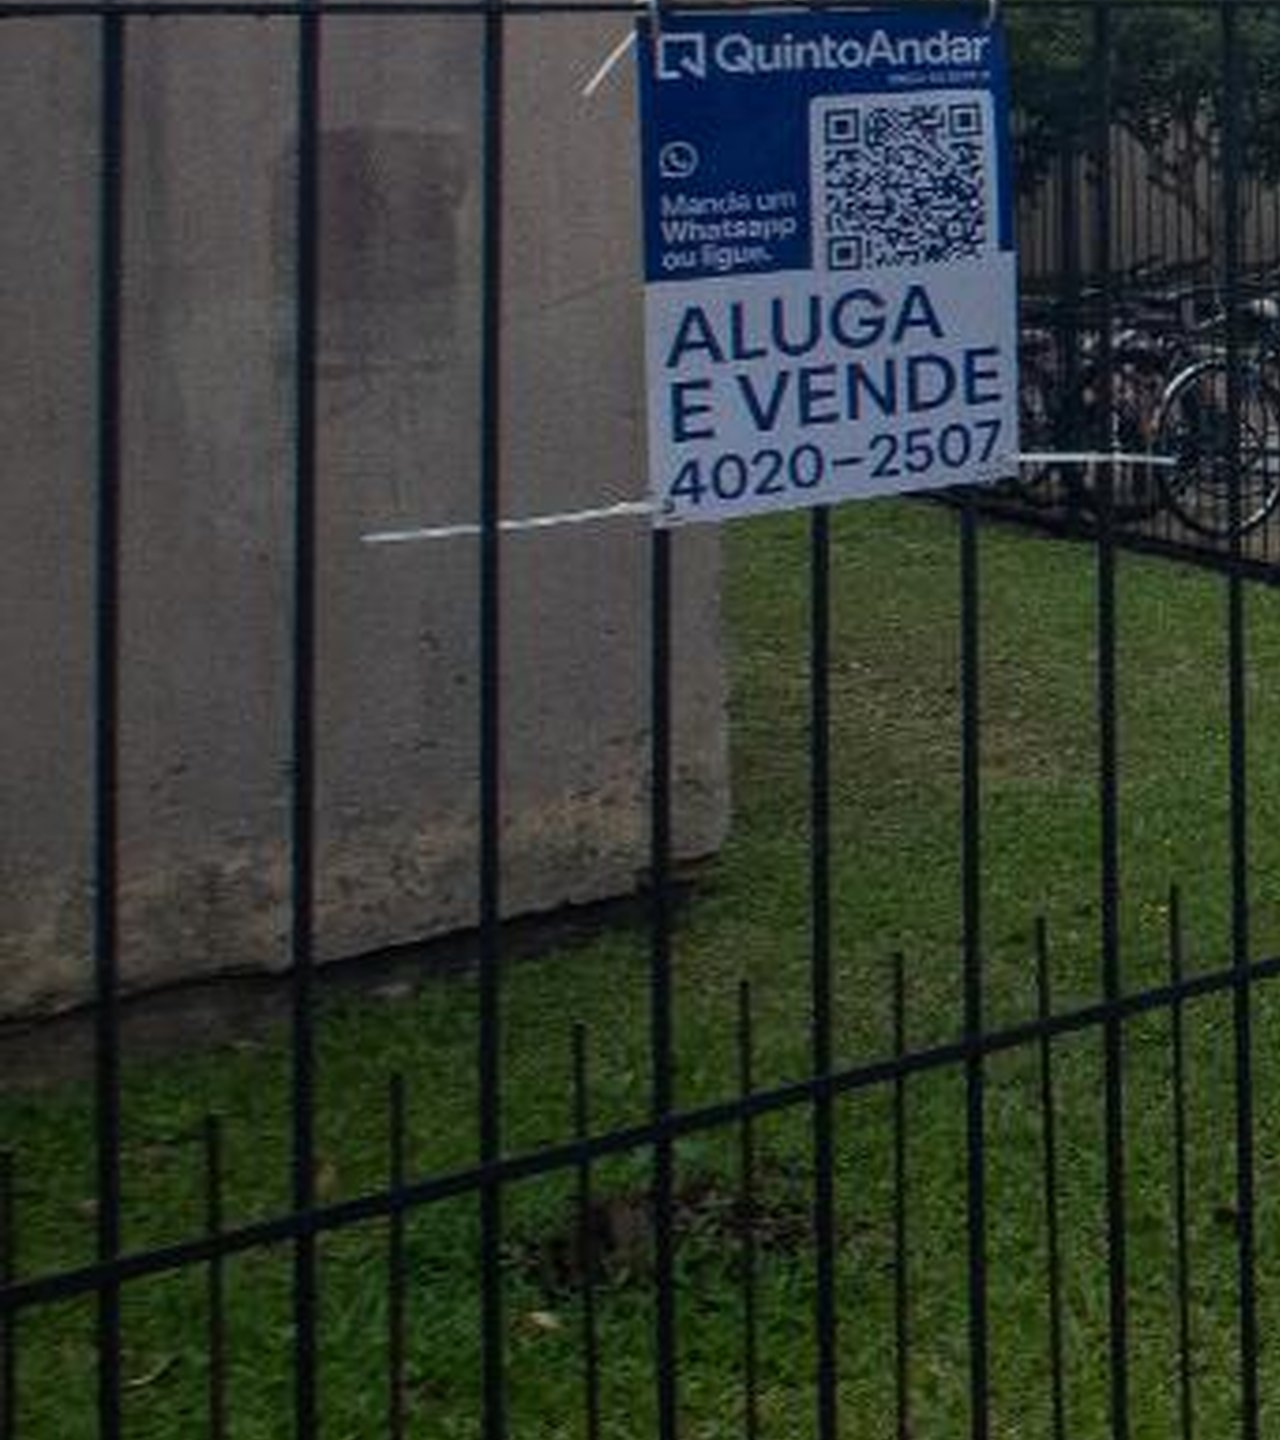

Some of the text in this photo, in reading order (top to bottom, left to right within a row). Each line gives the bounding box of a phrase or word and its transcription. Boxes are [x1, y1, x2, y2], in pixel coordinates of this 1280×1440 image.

[714, 30, 990, 74] QuintoAndar
[756, 192, 796, 212] um
[661, 252, 696, 271] ou
[666, 284, 945, 368] ALUGA
[671, 346, 1003, 443] E VENDE
[669, 419, 1002, 504] 4020-2507
